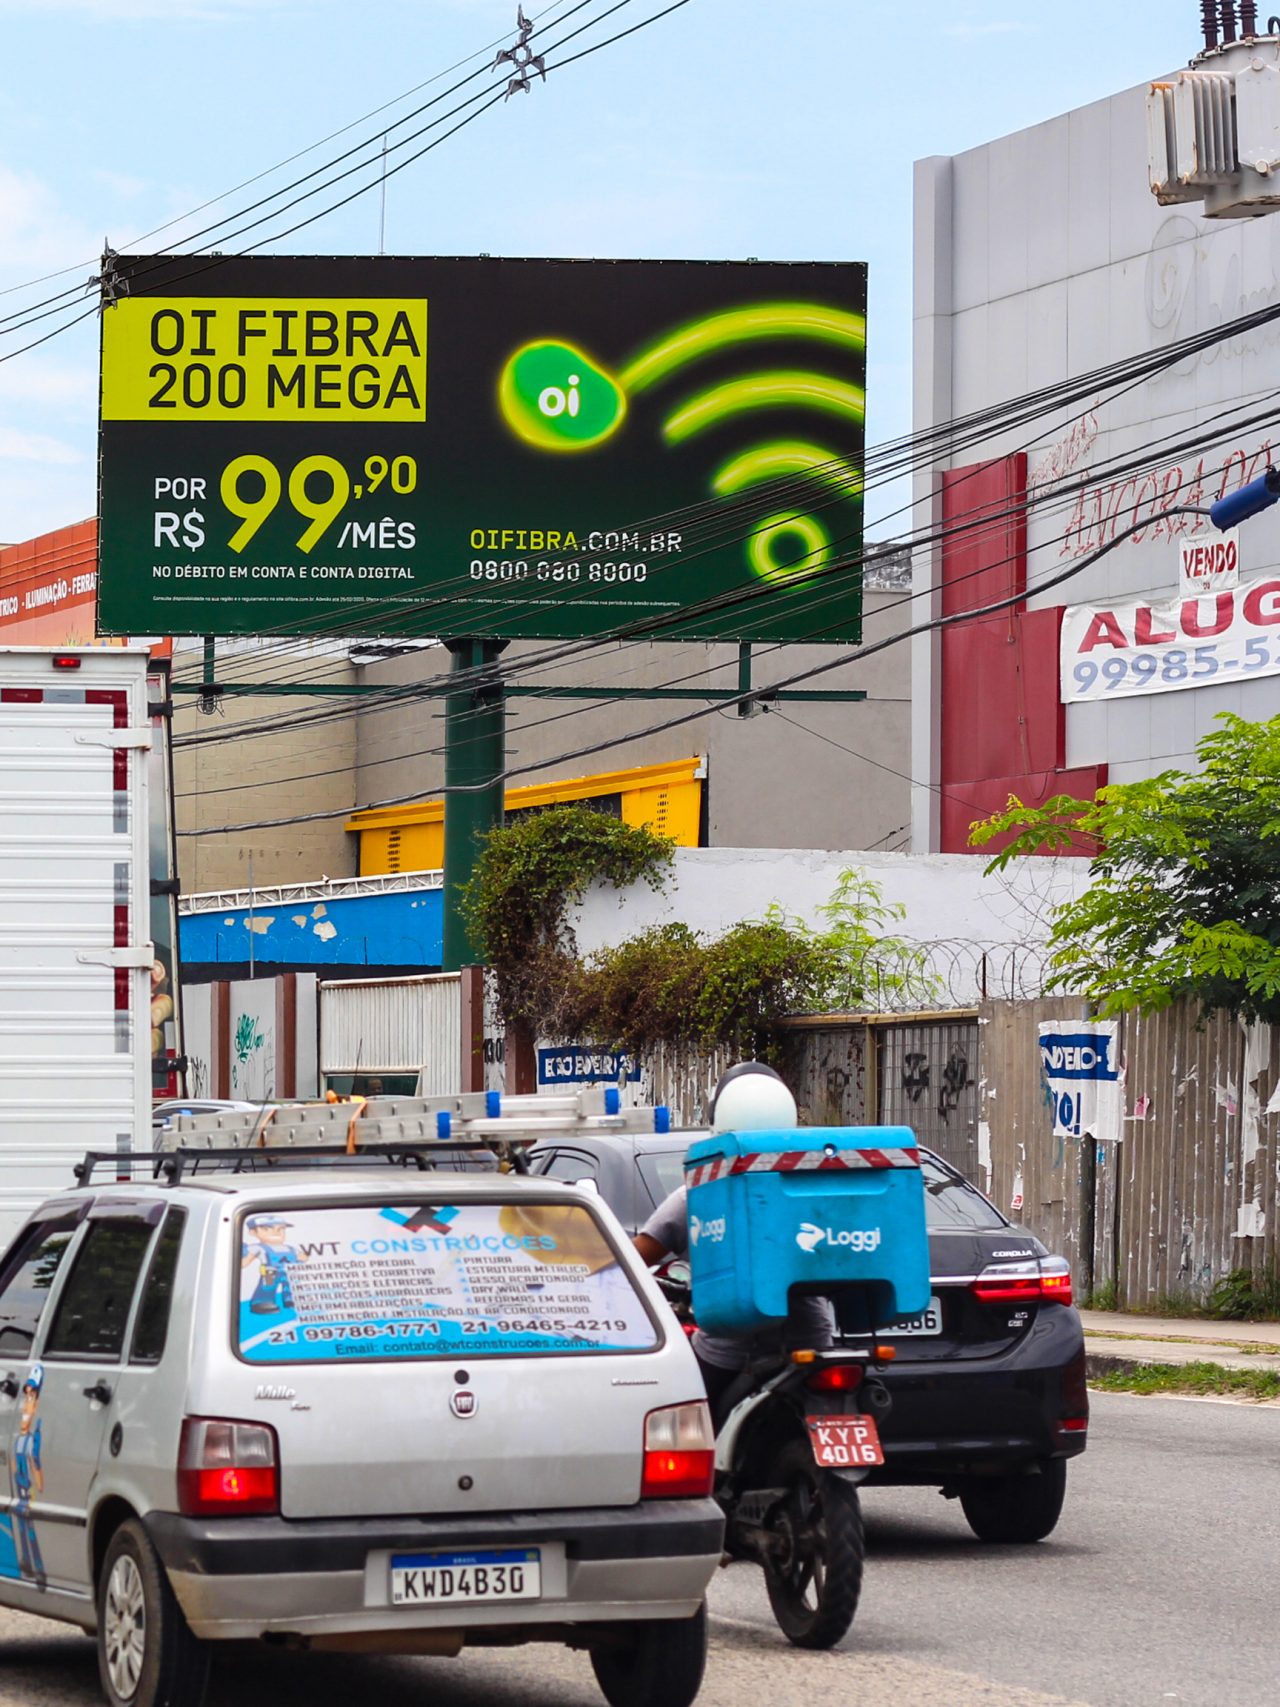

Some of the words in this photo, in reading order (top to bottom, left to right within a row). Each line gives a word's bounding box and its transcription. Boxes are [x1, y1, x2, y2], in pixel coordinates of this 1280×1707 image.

[150, 309, 216, 356] OI
[238, 310, 421, 357] FIBRA
[148, 363, 246, 409] 200
[267, 364, 421, 409] MEGA
[538, 374, 579, 417] oi
[154, 477, 207, 500] POR
[154, 507, 205, 552] R$
[470, 529, 682, 552] OIFIBRA.COM.BR
[1182, 540, 1237, 579] VENDO
[152, 566, 171, 578] NO
[175, 564, 225, 578] DÉBITO
[229, 566, 247, 578] EM
[251, 566, 296, 578] CONTA
[299, 567, 307, 578] E
[311, 566, 355, 579] CONTA
[358, 567, 415, 579] DIGITAL
[470, 560, 528, 581] 0800
[536, 561, 580, 581] 080
[589, 562, 647, 583] 8000
[25, 578, 67, 610] ILUMINAÇÃO
[1073, 635, 1280, 694] 99985-5
[701, 1215, 726, 1243] Loggi
[299, 1241, 340, 1256] WT
[351, 1233, 559, 1255] CONSTRUÇÕES
[826, 1227, 881, 1252] Loggi
[287, 1261, 366, 1272] MANUTENÇÃO
[370, 1259, 417, 1268] PREDIAL
[463, 1256, 513, 1264] PINTURA
[289, 1271, 359, 1281] PREVENTIVA
[372, 1268, 436, 1277] CORRETIVA
[466, 1266, 532, 1274] ESTRUTURA
[469, 1276, 506, 1284] GESSO
[511, 1275, 585, 1283] ACARTONADO
[373, 1277, 433, 1287] ELÉTRICAS
[471, 1286, 497, 1294] DRY
[474, 1295, 536, 1303] REFORMAS
[538, 1295, 555, 1303] EM
[557, 1295, 592, 1303] GERAL
[299, 1311, 381, 1324] MANUTENÇÃO
[467, 1307, 480, 1315] DE
[484, 1306, 500, 1315] AR
[503, 1306, 590, 1315] CONDICIONADO
[270, 1330, 297, 1343] 21
[305, 1323, 440, 1341] 99786-1771
[462, 1321, 488, 1333] 21
[497, 1319, 627, 1332] 96465-4219
[335, 1343, 379, 1355] Email:
[817, 1427, 868, 1445] KYP
[822, 1445, 877, 1464] 4016
